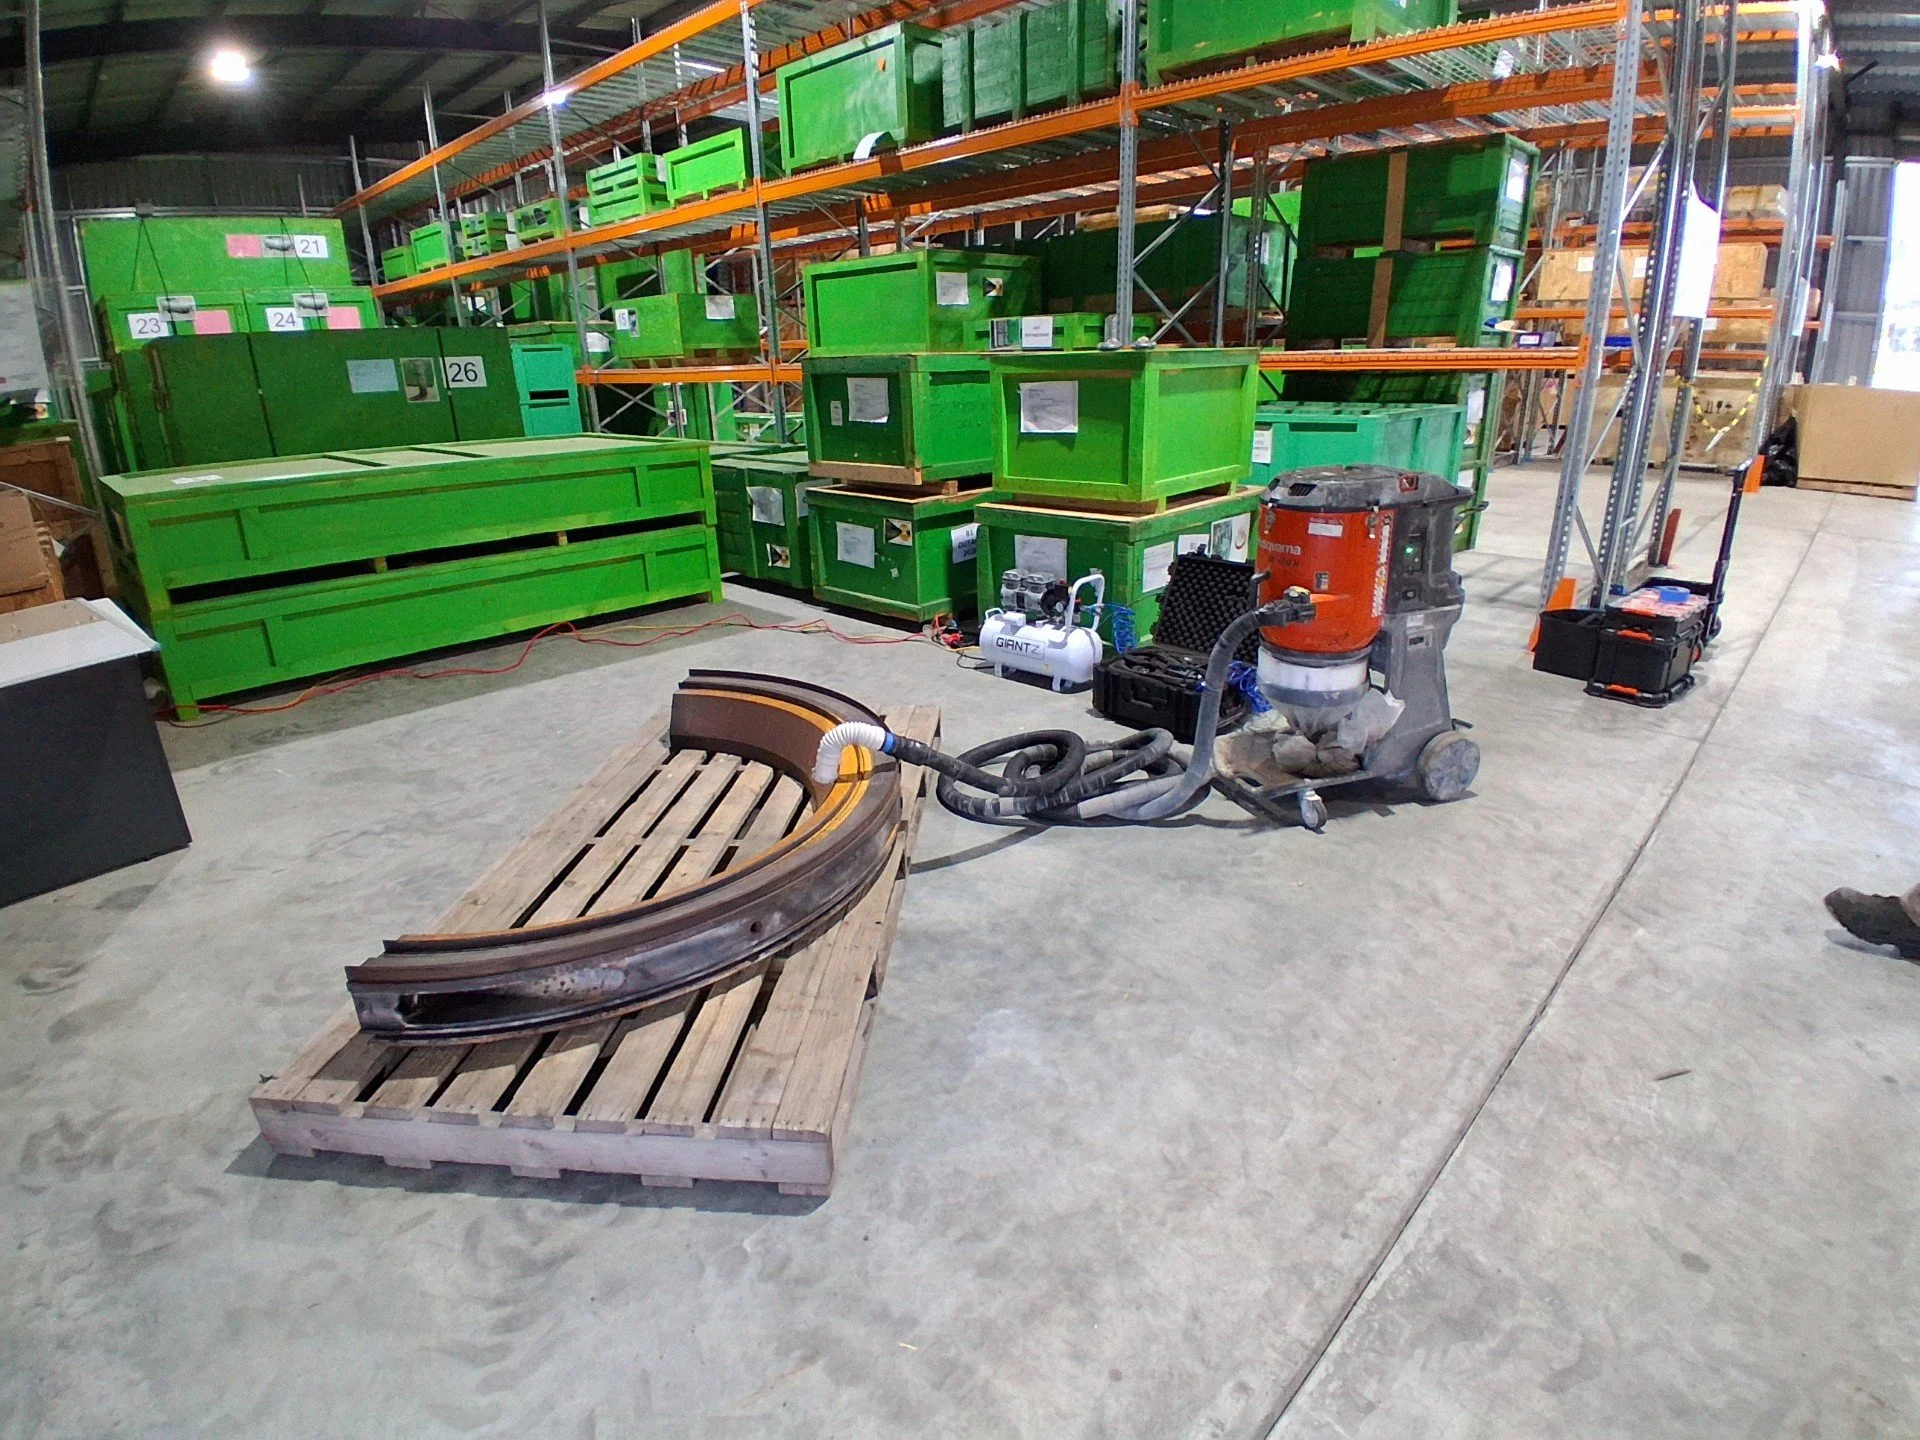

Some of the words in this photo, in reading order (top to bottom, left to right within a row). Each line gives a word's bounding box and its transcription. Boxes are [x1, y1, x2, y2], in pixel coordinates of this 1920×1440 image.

[300, 239, 320, 254] 21
[136, 318, 161, 335] 23
[273, 312, 296, 327] 24
[448, 362, 478, 383] 26
[957, 538, 977, 549] OUTA
[996, 637, 1040, 655] GIANTZ
